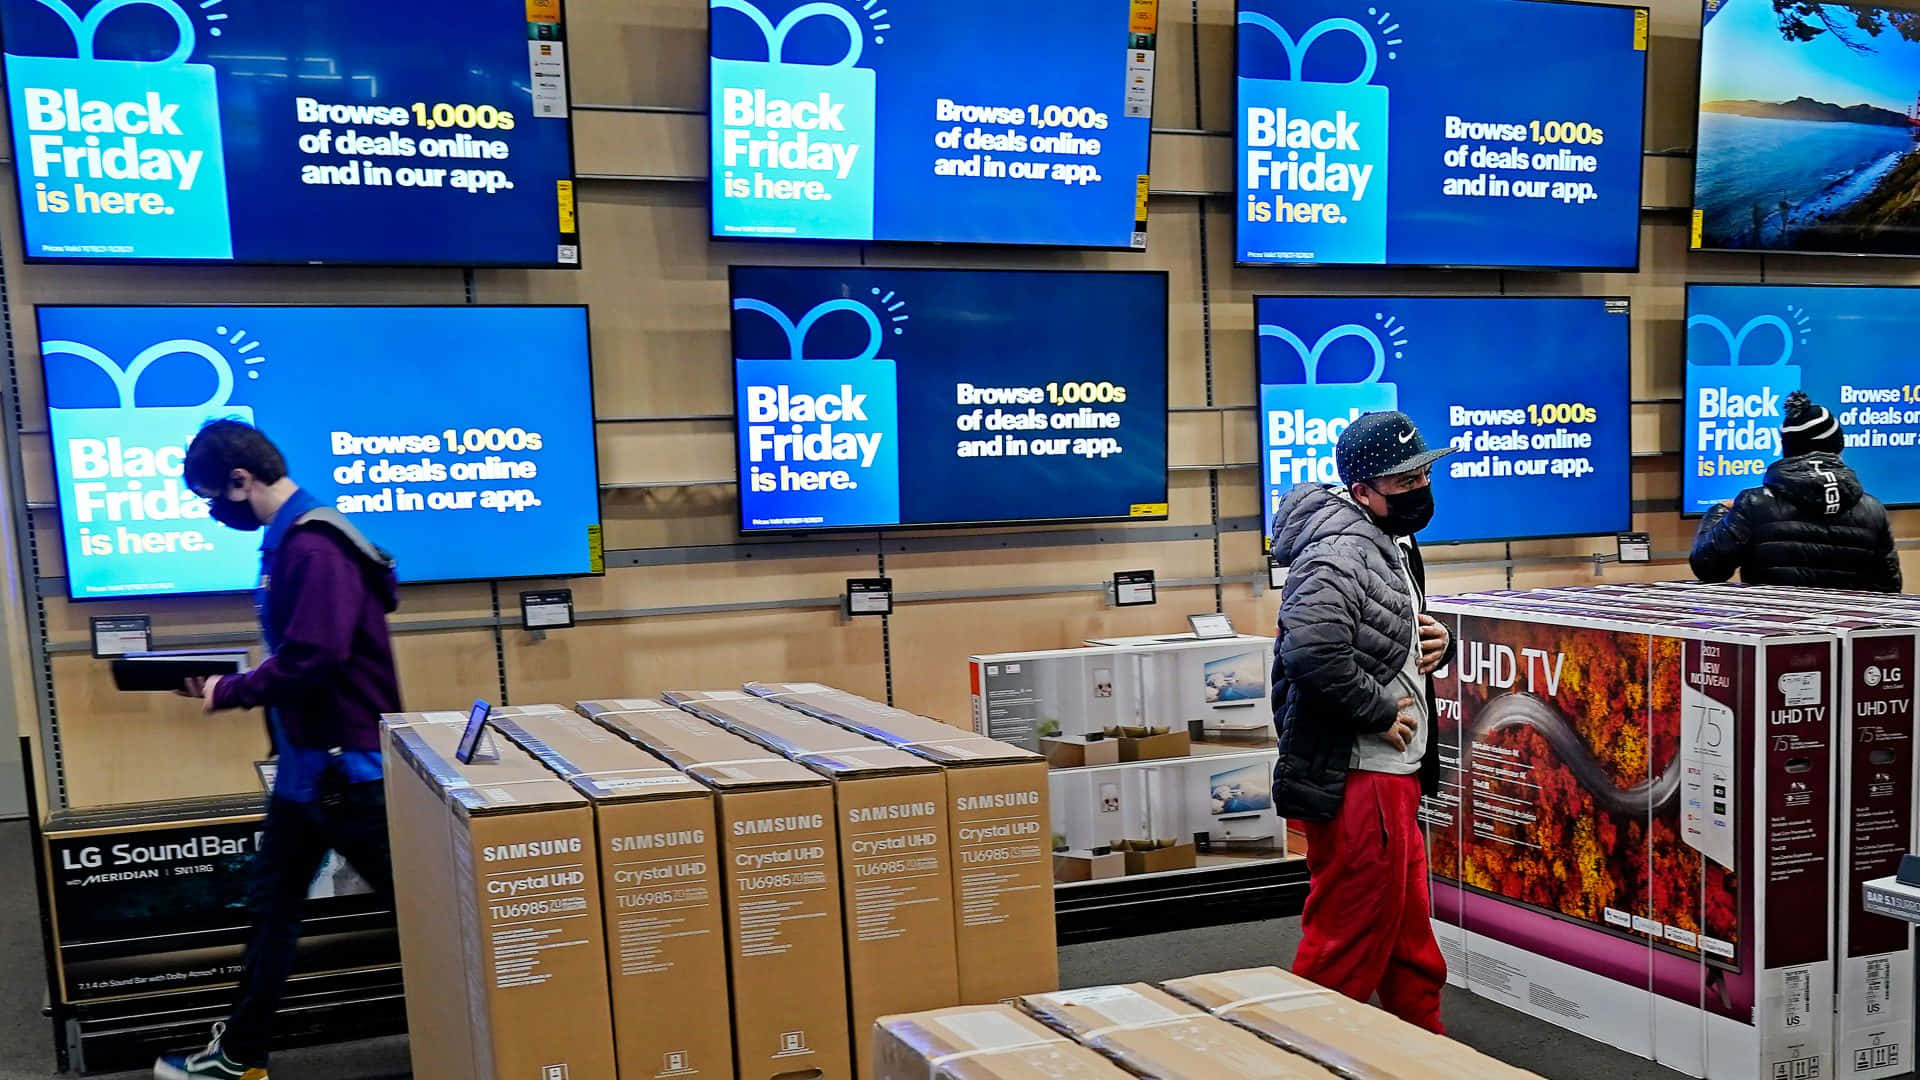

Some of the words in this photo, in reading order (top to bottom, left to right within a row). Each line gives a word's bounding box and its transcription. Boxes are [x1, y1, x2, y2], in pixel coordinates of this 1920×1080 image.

[24, 88, 184, 135] Black
[296, 97, 410, 125] Browse
[411, 102, 515, 130] 1,000s
[724, 87, 846, 131] Black
[936, 98, 1025, 126] Browse
[1028, 104, 1109, 130] 1,000s
[1247, 107, 1361, 150] Black
[1445, 116, 1528, 142] Browse
[1529, 120, 1604, 145] 1,000s
[299, 129, 331, 153] of
[335, 130, 416, 157] deals
[419, 133, 509, 160] online
[934, 127, 962, 149] of
[964, 128, 1027, 153] deals
[1030, 132, 1101, 155] online
[29, 134, 204, 190] Friday
[724, 129, 859, 180] Friday
[1443, 145, 1469, 167] of
[1470, 146, 1529, 169] deals
[1531, 149, 1597, 172] online
[301, 160, 360, 185] and
[363, 161, 393, 186] in
[396, 168, 447, 187] our
[450, 168, 514, 194] app.
[934, 154, 981, 177] and
[983, 155, 1006, 178] in
[1008, 161, 1050, 180] our
[1051, 163, 1102, 185] app.
[1247, 150, 1374, 201] Friday
[724, 171, 750, 198] is
[754, 172, 832, 201] here.
[1443, 173, 1486, 196] and
[1489, 174, 1509, 197] in
[1511, 181, 1550, 198] our
[1551, 182, 1598, 204] app.
[35, 182, 70, 213] is
[74, 183, 175, 215] here.
[1247, 194, 1272, 222] is
[1275, 195, 1347, 224] here.
[747, 384, 869, 423] Black
[957, 382, 1044, 405] Browse
[1046, 381, 1126, 406] 1,000s
[1699, 386, 1780, 418] Black
[1840, 385, 1901, 404] Browse
[957, 409, 983, 431] of
[985, 408, 1049, 430] deals
[1050, 407, 1121, 429] online
[1450, 405, 1525, 426] Browse
[1527, 402, 1597, 426] 1,000s
[1839, 407, 1858, 425] of
[1859, 407, 1902, 425] deals
[331, 431, 441, 456] Browse
[443, 428, 543, 455] 1,000s
[748, 423, 883, 468] Friday
[957, 435, 1002, 457] and
[1005, 434, 1028, 456] in
[1030, 438, 1071, 456] our
[1072, 437, 1123, 458] app.
[1450, 430, 1472, 452] of
[1475, 430, 1530, 452] deals
[1531, 428, 1592, 450] online
[1698, 420, 1784, 456] Friday
[1843, 429, 1870, 448] nd
[1872, 429, 1887, 446] in
[1889, 432, 1917, 446] our
[333, 460, 365, 485] of
[368, 458, 447, 484] deals
[450, 456, 537, 481] online
[1269, 447, 1342, 485] Frid
[1450, 456, 1490, 478] and
[1492, 456, 1512, 477] in
[1514, 459, 1549, 475] our
[1551, 456, 1594, 478] app.
[1697, 455, 1716, 477] is
[750, 466, 777, 492] is
[780, 465, 858, 491] here.
[74, 479, 216, 523] Frida
[336, 488, 392, 514] and
[395, 488, 424, 512] in
[427, 489, 477, 511] our
[480, 488, 542, 512] app.
[80, 527, 113, 556] is
[116, 526, 215, 555] here.
[1460, 639, 1517, 689] UHD
[1520, 647, 1565, 697] TV
[1690, 672, 1730, 688] NOUVEAU
[1882, 668, 1902, 682] LG
[1436, 697, 1461, 721] P70
[1771, 708, 1803, 725] UHD
[1804, 706, 1826, 723] TV
[1857, 700, 1888, 717] UHD
[1890, 699, 1910, 714] TV
[848, 801, 936, 823] SAMSUNG
[956, 790, 1040, 811] SAMSUNG
[732, 814, 824, 836] SAMSUNG
[959, 824, 1009, 842] Crystal
[1012, 821, 1040, 835] UHD
[483, 838, 582, 861] SAMSUNG
[611, 829, 705, 852] SAMSUNG
[851, 837, 905, 855] Crystal
[907, 833, 937, 847] UHD
[62, 846, 102, 870] LG
[735, 849, 792, 869] Crystal
[794, 846, 825, 861] UHD
[960, 847, 1009, 864] TU6985
[81, 869, 159, 886] MERIDIAN
[613, 865, 673, 886] Crystal
[675, 862, 707, 877] UHD
[853, 860, 905, 877] TU6985
[487, 875, 549, 896] Crystal
[550, 871, 584, 887] UHD
[736, 873, 791, 891] TU6985
[490, 901, 549, 920] TU6985
[616, 890, 672, 908] TU6985
[1866, 1003, 1880, 1013] US
[1786, 1016, 1801, 1027] US
